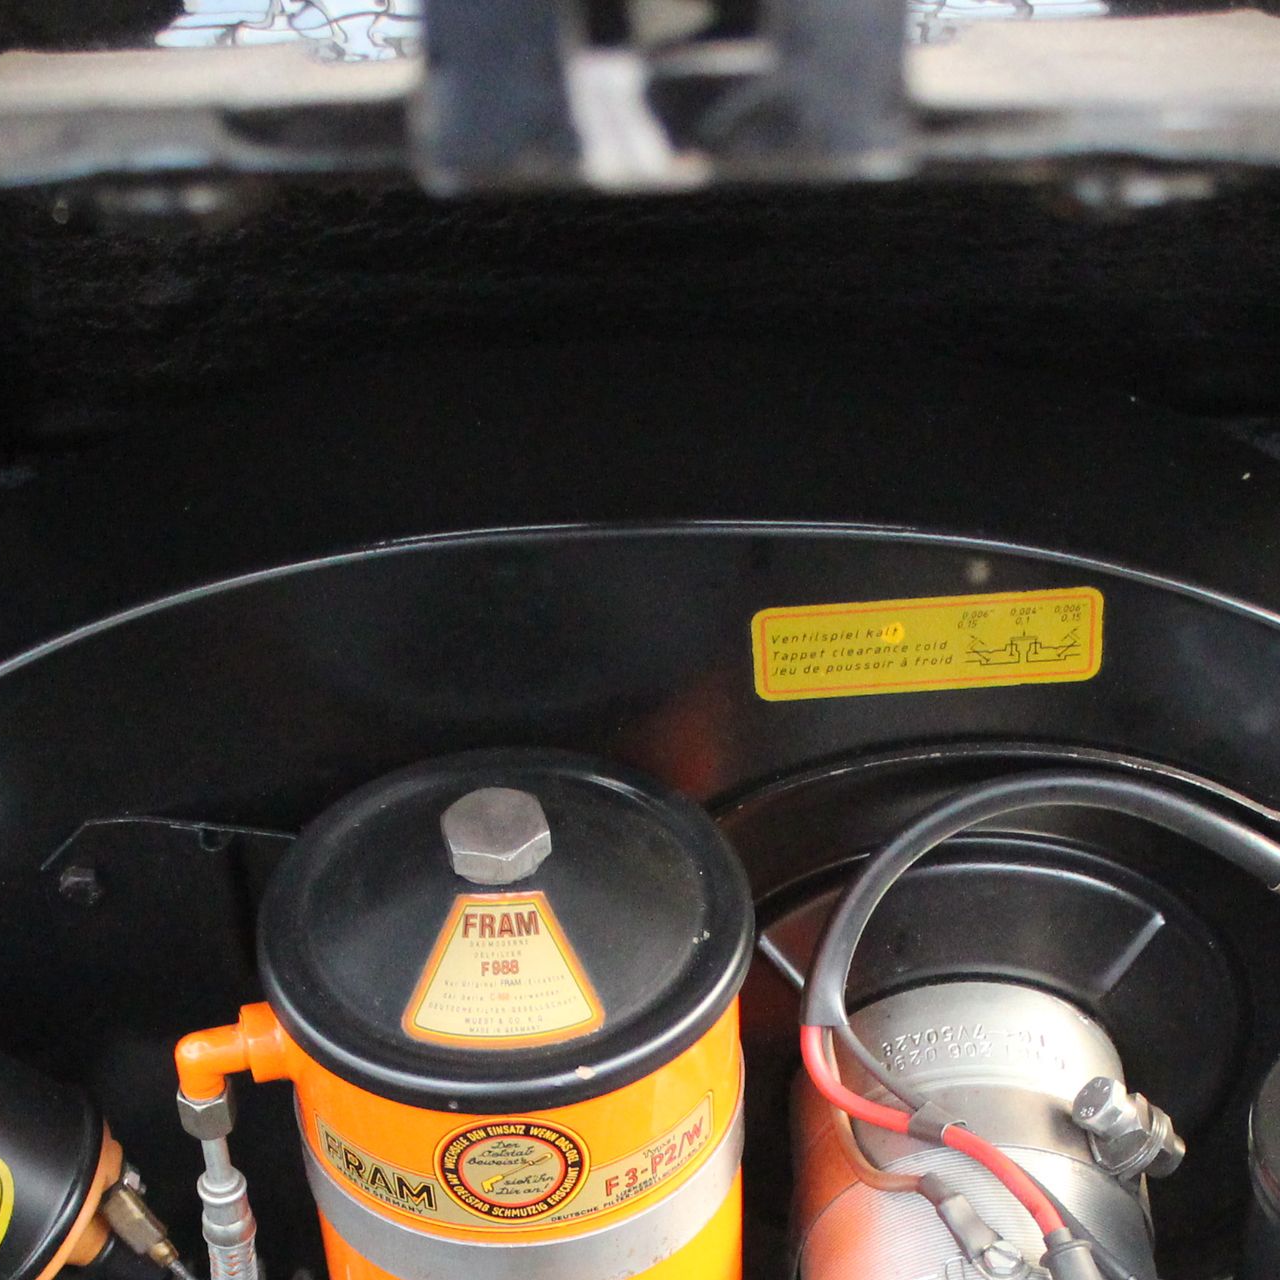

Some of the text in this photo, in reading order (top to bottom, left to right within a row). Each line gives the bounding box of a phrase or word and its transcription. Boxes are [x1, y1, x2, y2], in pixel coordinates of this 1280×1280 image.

[770, 626, 899, 645] Ventilspiel kalt
[771, 640, 949, 663] Tappet clearance cold
[771, 667, 797, 677] Jeu
[803, 663, 820, 674] de
[825, 659, 895, 676] poussoir
[914, 654, 954, 667] froid
[461, 910, 541, 939] FRAM
[500, 979, 522, 987] FRAM
[443, 1124, 580, 1170] WECHSELE DEN EINSATZ WENN DAS OEL
[323, 1129, 438, 1212] FRAM
[444, 1166, 580, 1218] AM OELSTAB SCHMUTZIG ERSCHEINT
[551, 1205, 600, 1223] DEUTSCHE
